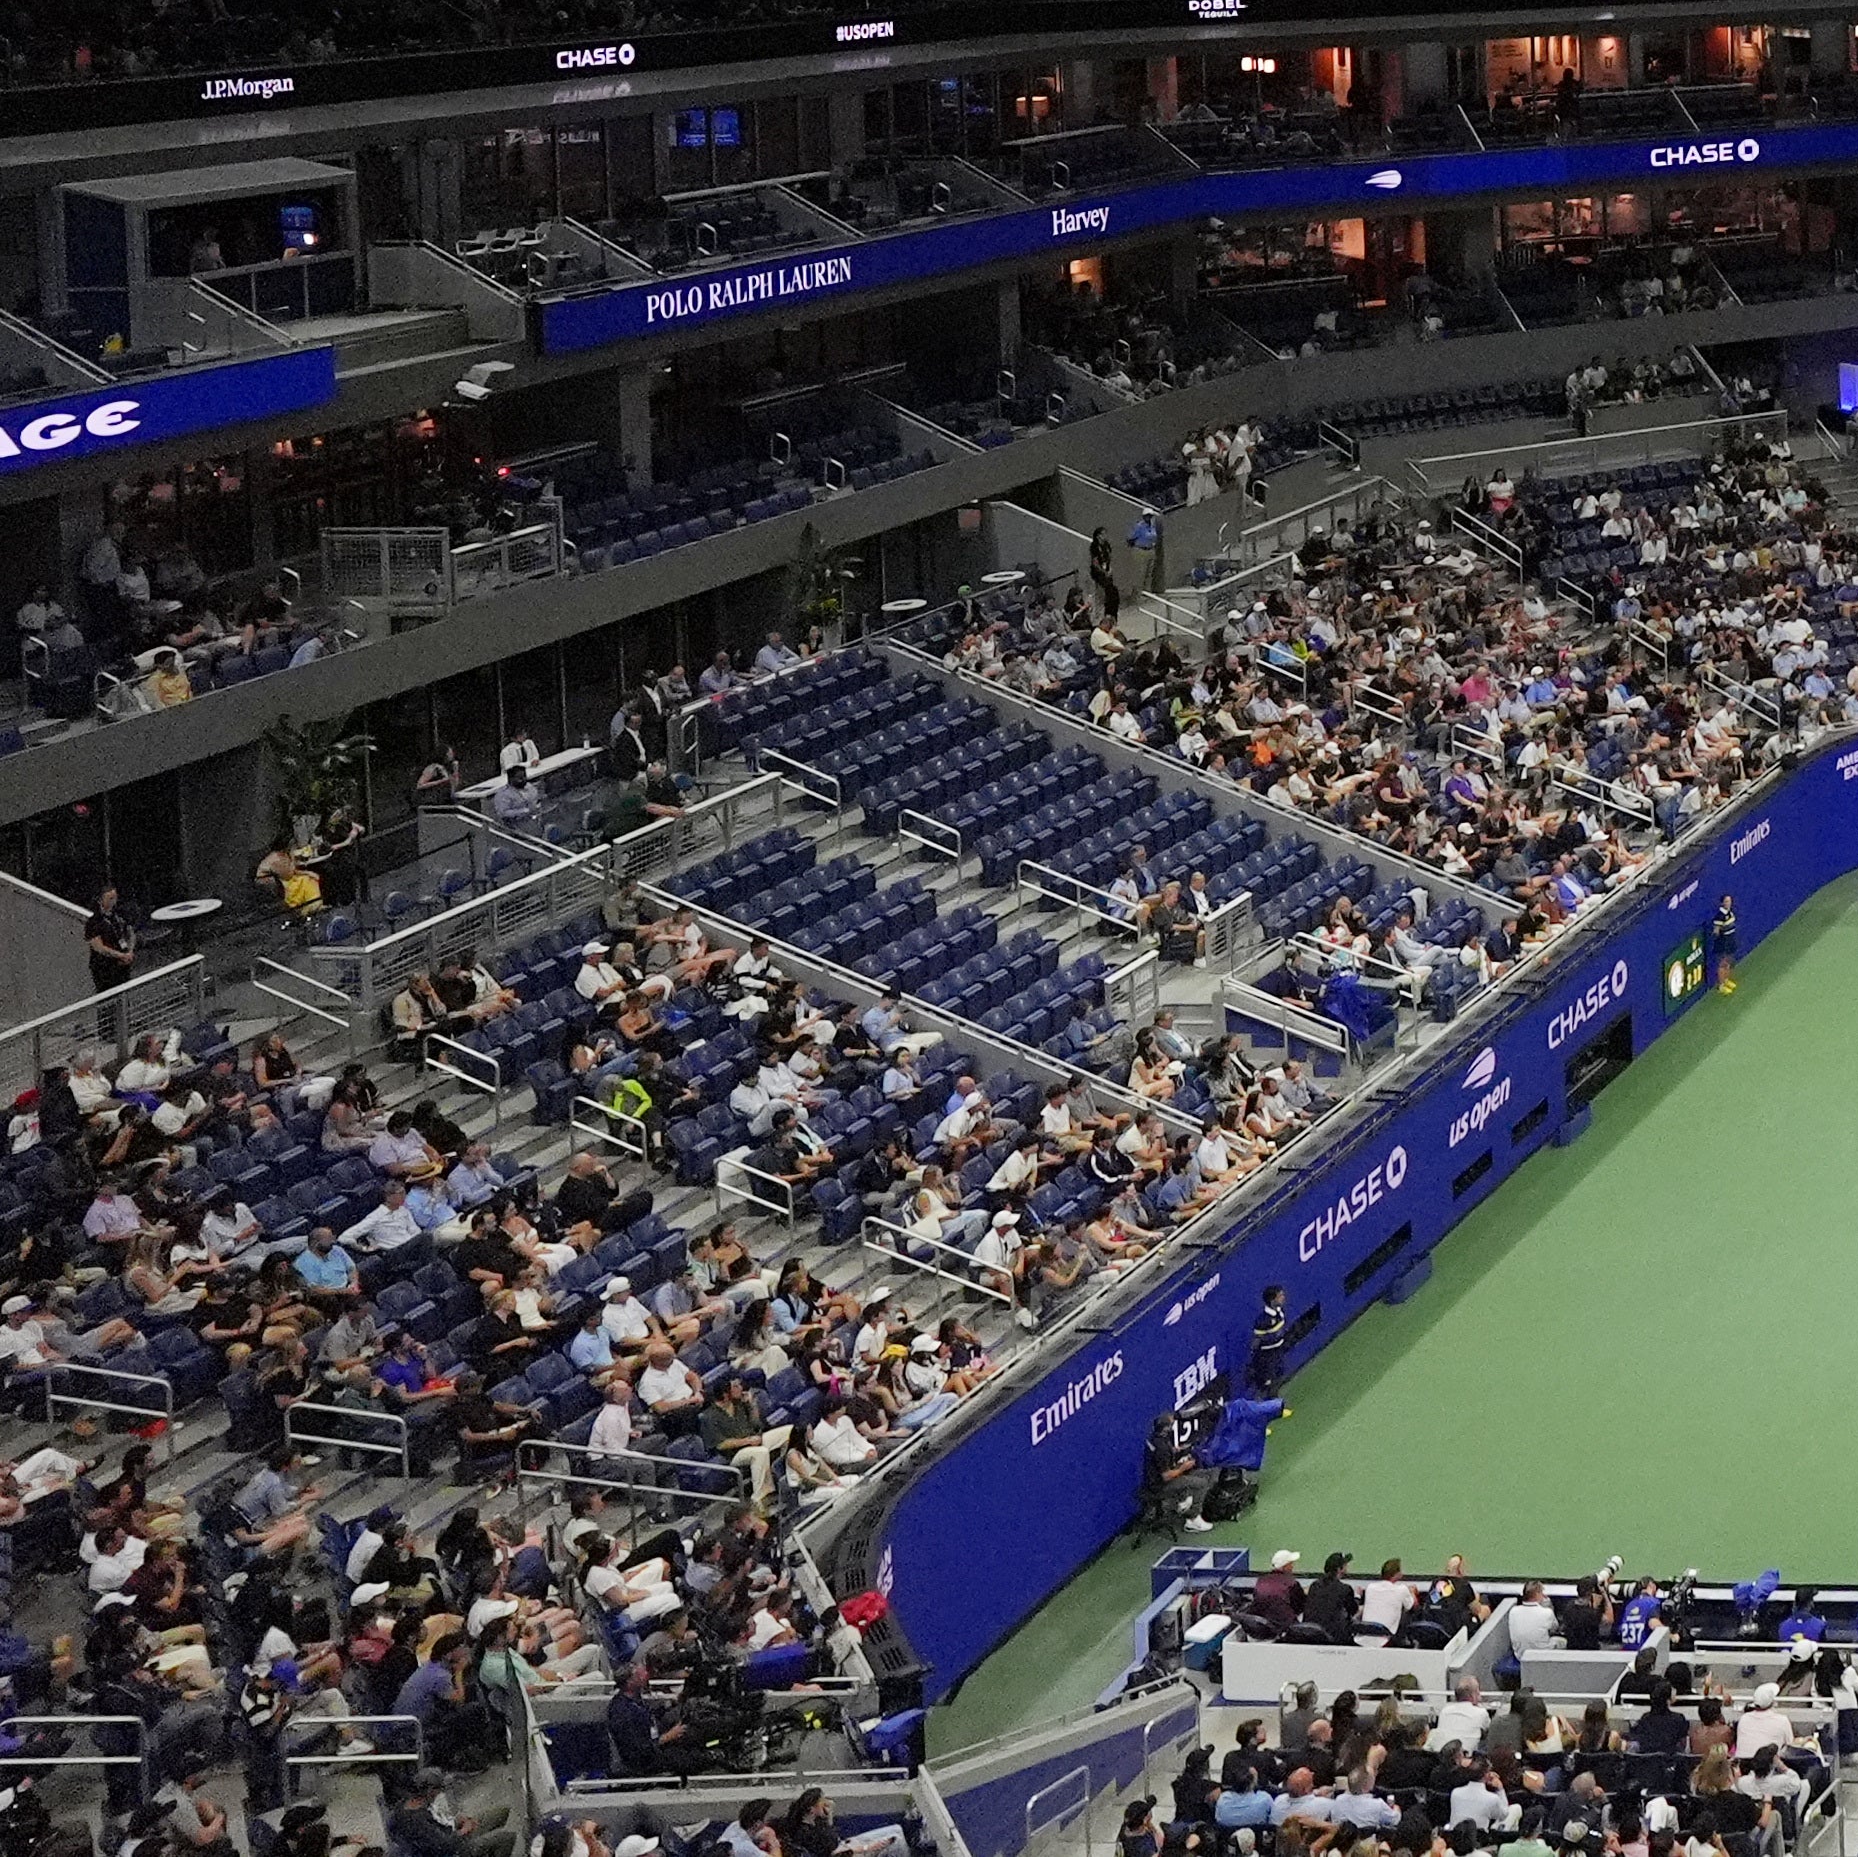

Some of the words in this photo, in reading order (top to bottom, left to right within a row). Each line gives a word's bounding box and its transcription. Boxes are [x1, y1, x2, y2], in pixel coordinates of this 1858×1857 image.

[835, 21, 894, 42] #USOPEN
[556, 47, 616, 69] CHASE
[201, 74, 295, 100] J.P.Morgan
[1650, 142, 1734, 167] CHASE
[1052, 206, 1110, 236] Harvey
[646, 286, 703, 323] POLO
[708, 271, 773, 310] RALPH
[778, 256, 852, 296] LAUREN
[1730, 819, 1770, 865] Emirates
[1547, 974, 1610, 1050] CHASE
[1449, 1111, 1470, 1148] us
[1470, 1076, 1511, 1132] open
[1299, 1164, 1384, 1263] CHASE
[1184, 1293, 1197, 1311] us
[1196, 1273, 1220, 1302] open
[1030, 1349, 1124, 1446] Emirates
[1173, 1345, 1218, 1412] IBM
